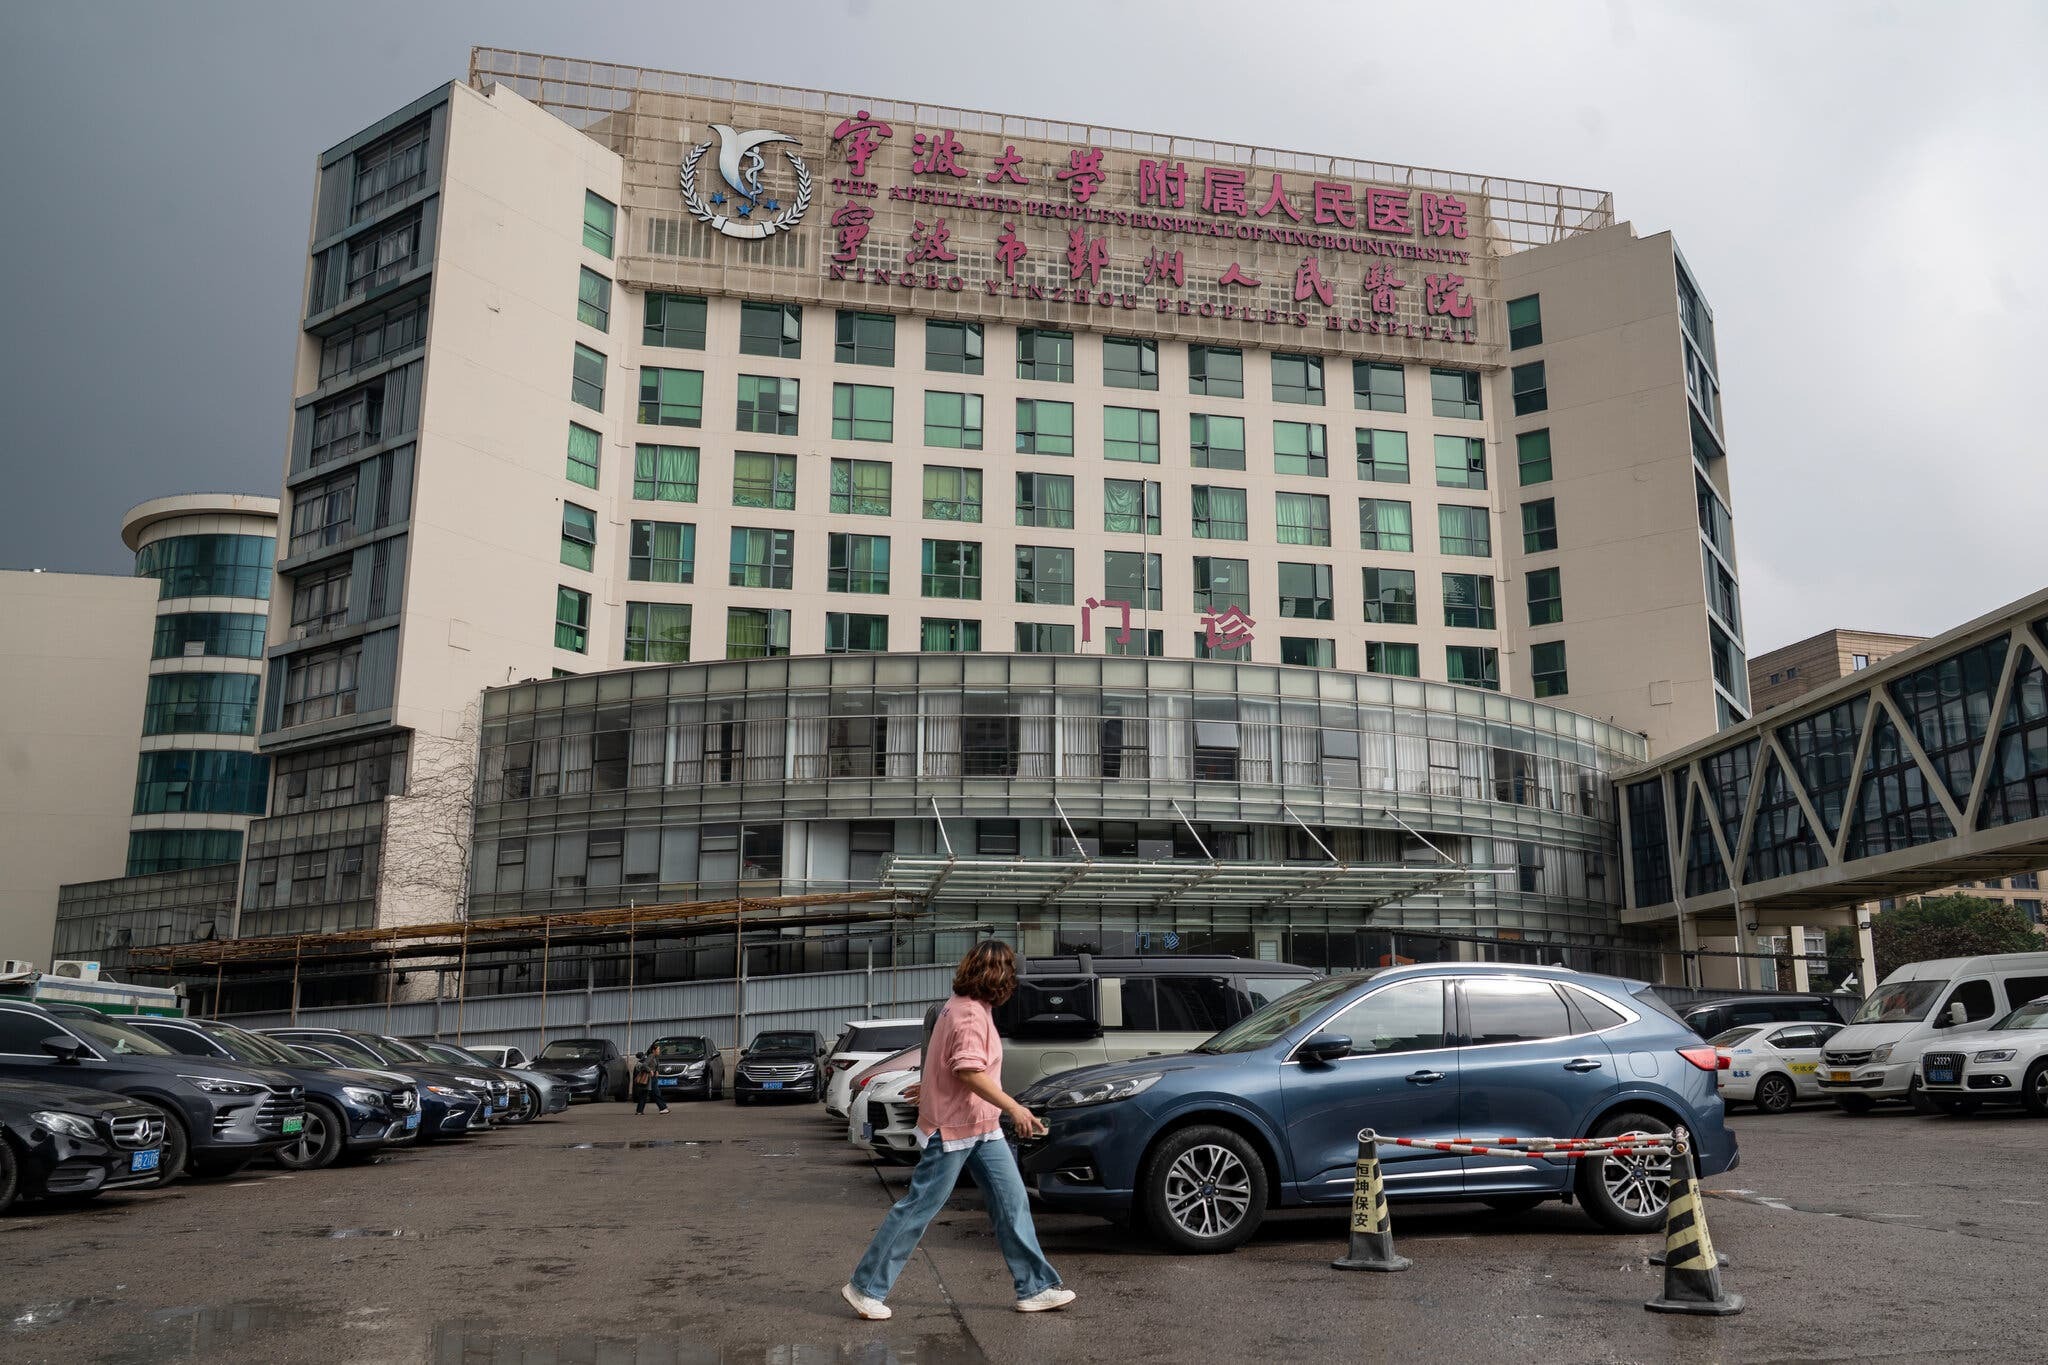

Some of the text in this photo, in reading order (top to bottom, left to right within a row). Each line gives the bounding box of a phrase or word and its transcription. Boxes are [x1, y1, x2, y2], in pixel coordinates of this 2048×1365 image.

[832, 178, 879, 198] THE
[889, 184, 1023, 215] AFFILIATED
[1027, 199, 1128, 226] PEOPLE'S
[1130, 212, 1235, 238] HOSPITAL
[1237, 225, 1263, 242] OF
[829, 263, 1476, 345] NINGBO YINZHOU PEOPLE'S HOSPITAL
[1081, 597, 1257, 651] 门诊
[1135, 931, 1181, 950] 门诊
[1354, 1163, 1370, 1228] 恒坤保安
